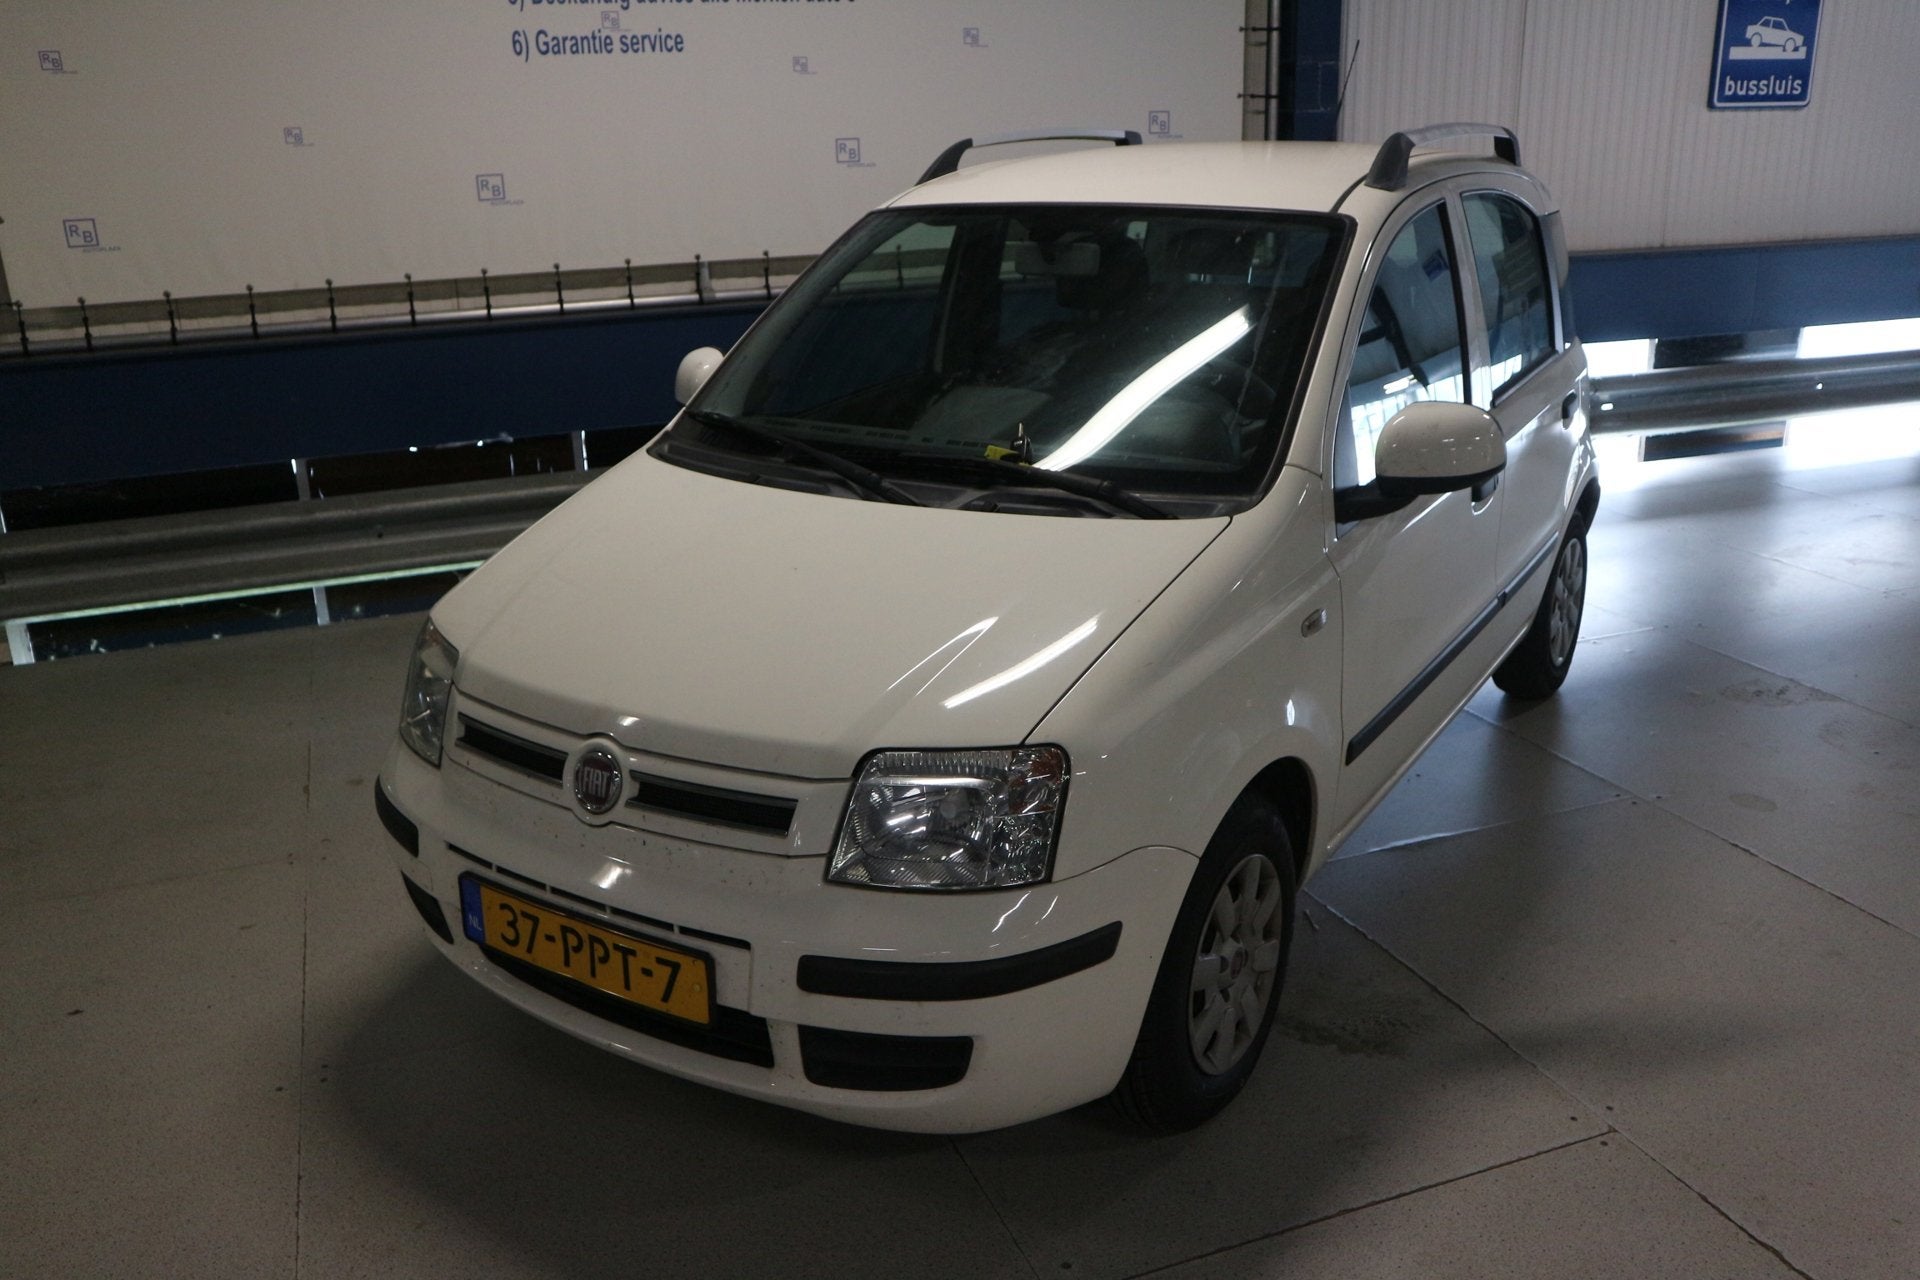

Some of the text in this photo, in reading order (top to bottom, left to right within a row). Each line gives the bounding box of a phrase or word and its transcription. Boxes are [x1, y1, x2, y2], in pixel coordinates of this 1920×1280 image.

[511, 28, 685, 63] 6) Garantie service
[1724, 75, 1803, 96] bussluis
[583, 766, 610, 798] FIAT
[468, 913, 483, 931] NL
[499, 903, 682, 1003] 37-PPT-7
